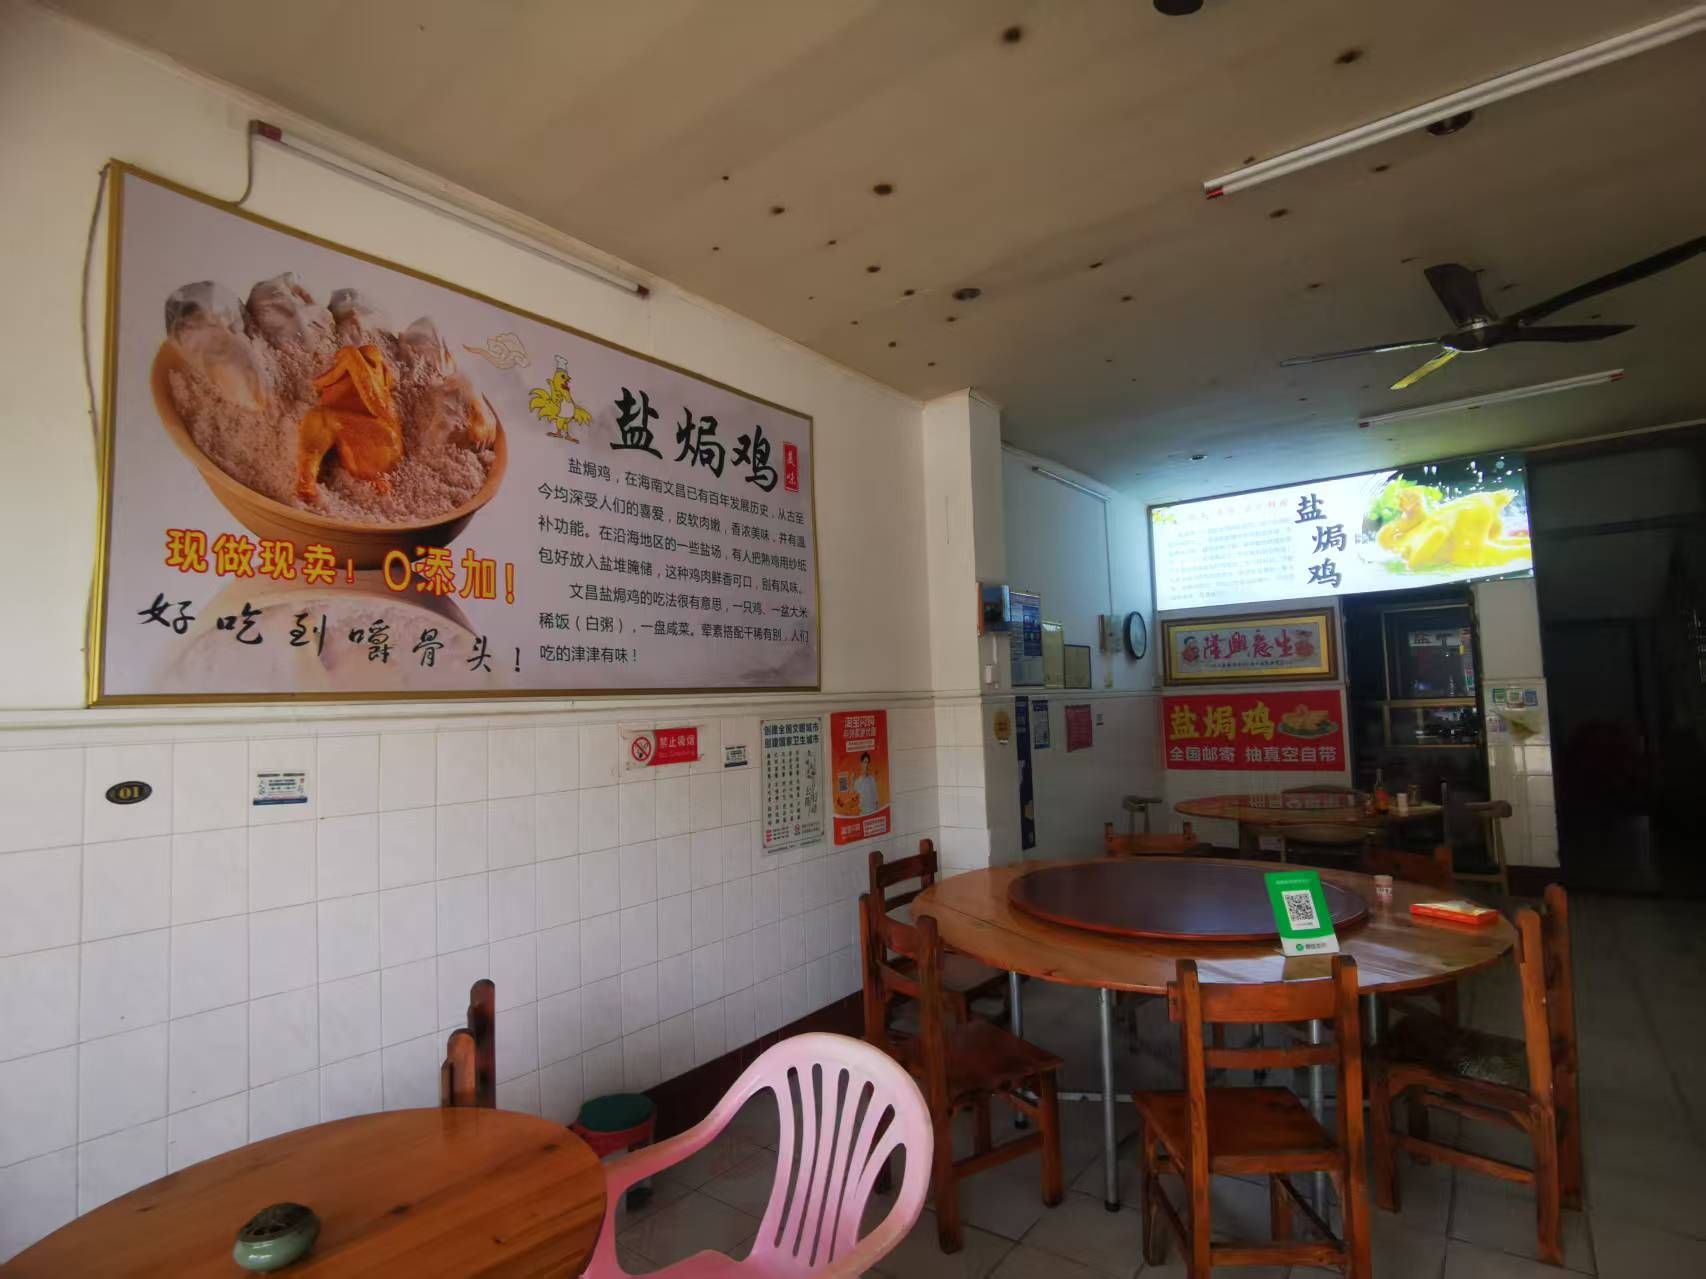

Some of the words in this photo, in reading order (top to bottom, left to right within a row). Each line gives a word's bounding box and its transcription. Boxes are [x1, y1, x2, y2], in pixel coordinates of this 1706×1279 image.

[609, 386, 778, 494] 盐焗鸡
[1294, 492, 1348, 588] 盐焗鸡
[539, 645, 638, 663] 吃的津津有味！
[1169, 700, 1276, 741] 盐焗鸡
[1169, 745, 1236, 763] 全国邮寄
[119, 786, 139, 799] 01
